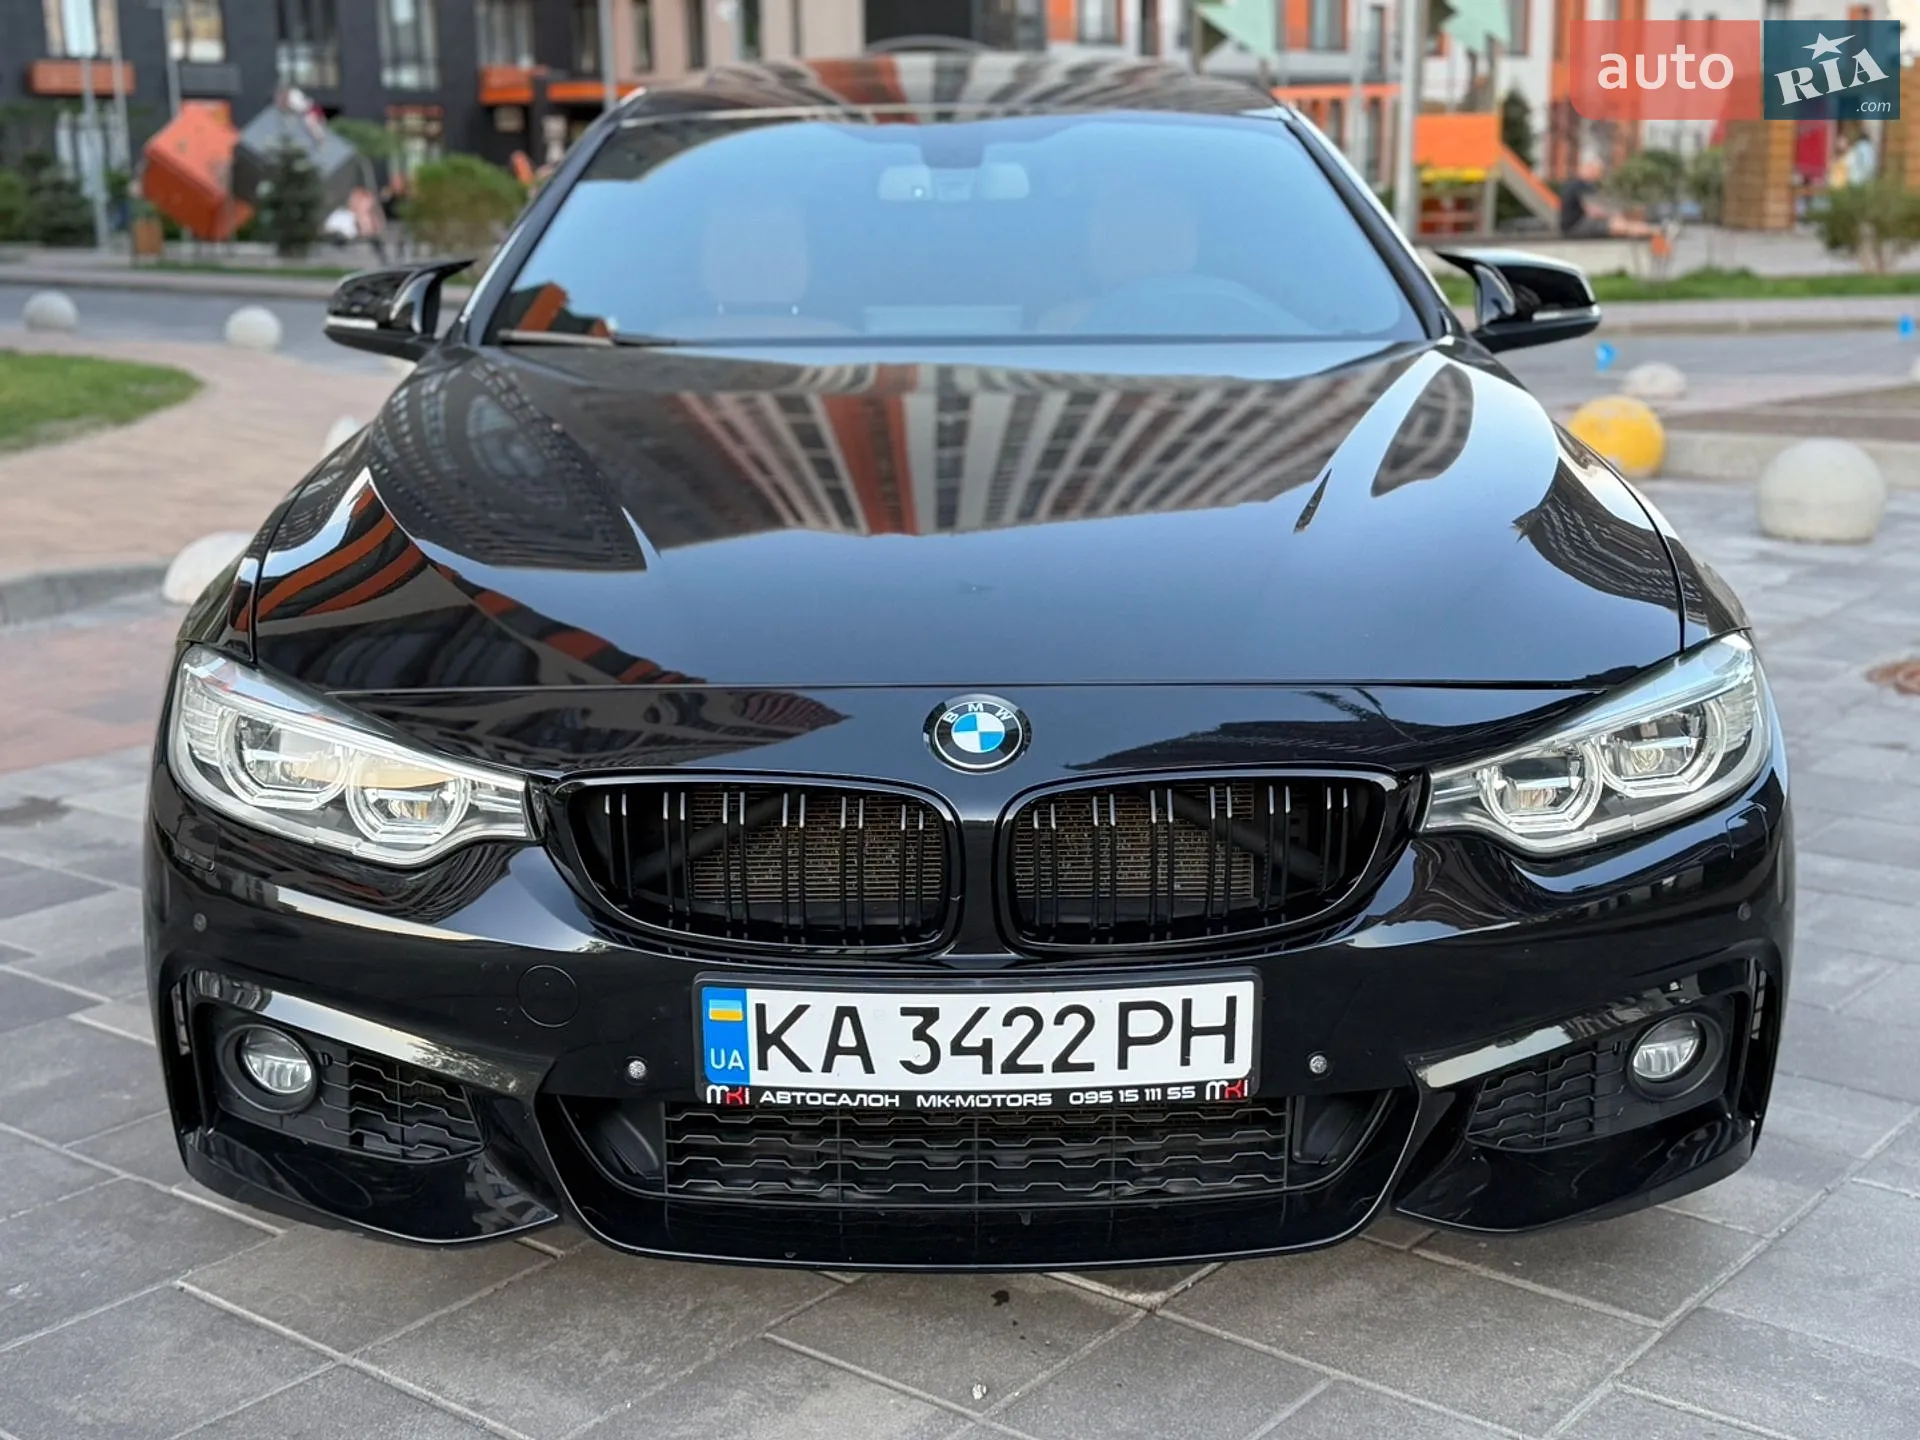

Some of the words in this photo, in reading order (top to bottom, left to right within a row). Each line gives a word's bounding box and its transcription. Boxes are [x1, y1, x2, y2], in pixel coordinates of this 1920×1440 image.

[942, 702, 1012, 724] BMW
[755, 1003, 876, 1074] KA
[899, 1005, 1096, 1075] 3422
[1117, 995, 1238, 1071] PH
[710, 1048, 744, 1070] UA
[760, 1091, 900, 1107] АВТОСАЛОН
[916, 1093, 1052, 1108] MK-MOTORS
[1069, 1090, 1113, 1105] 095
[1119, 1089, 1139, 1102] 15
[1144, 1087, 1162, 1101] 111
[1167, 1085, 1196, 1099] 55
